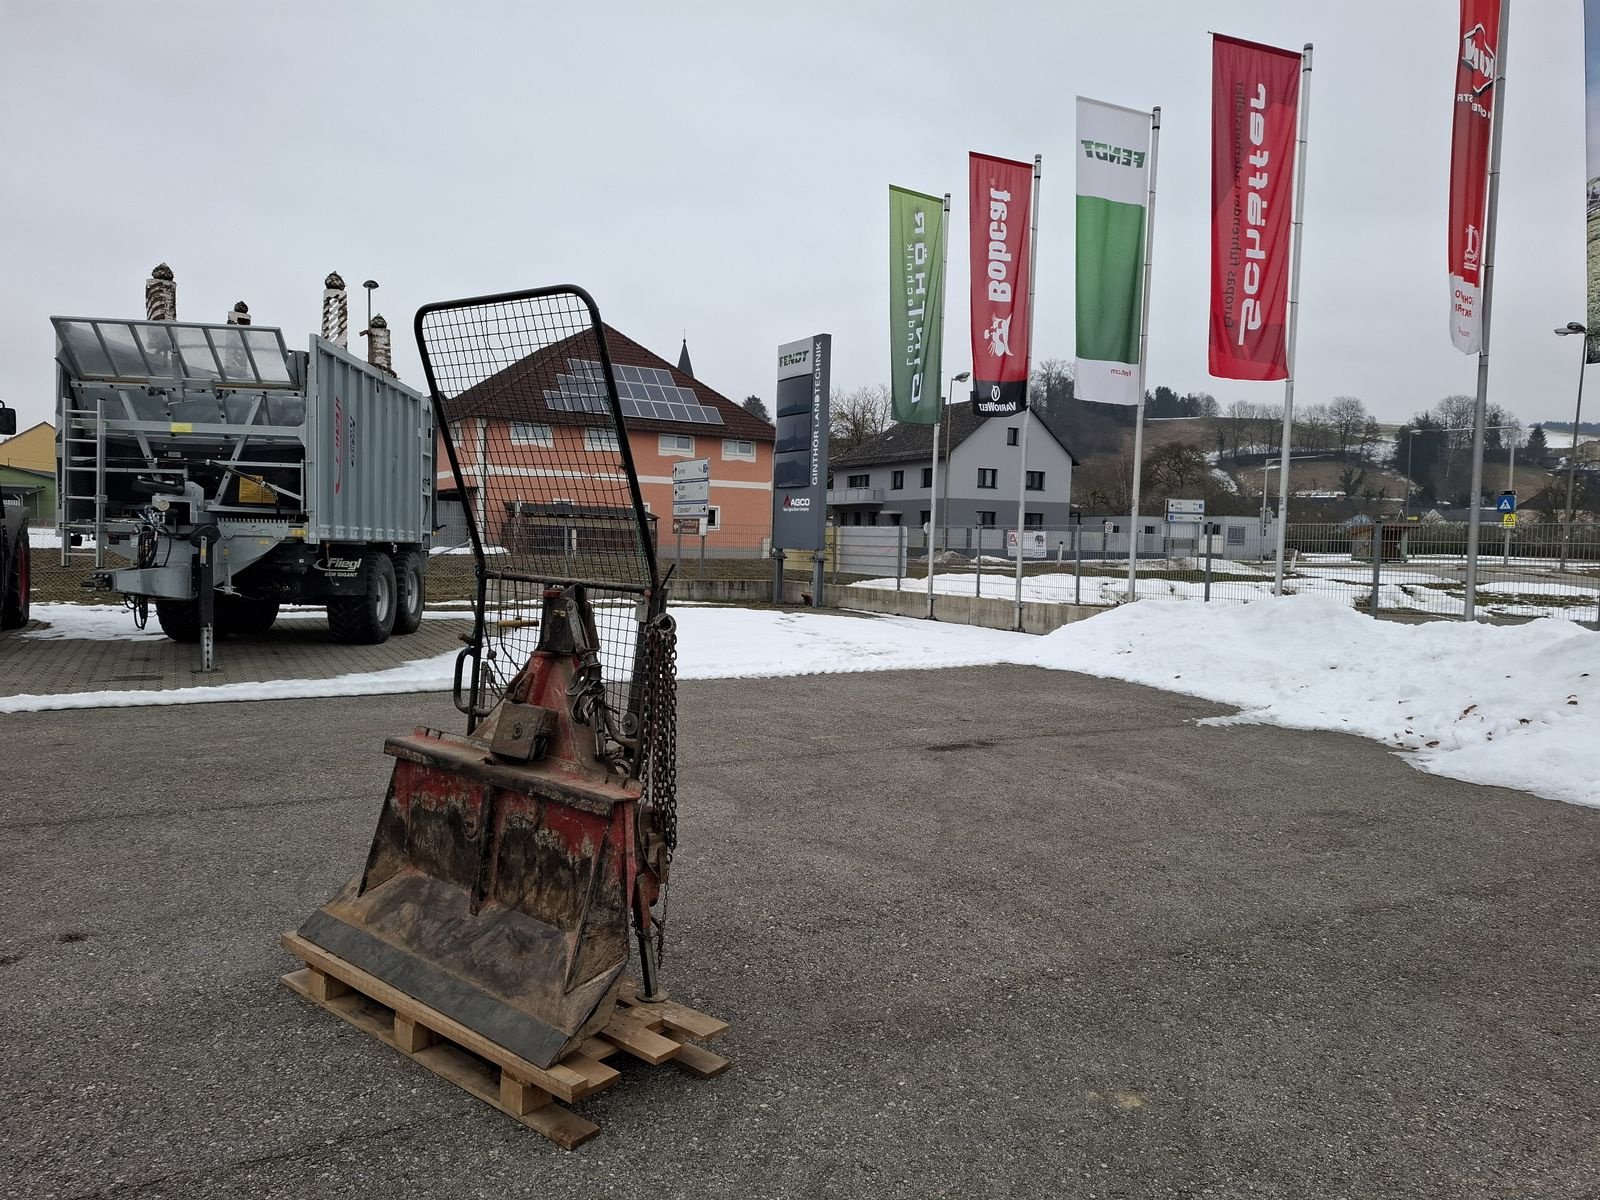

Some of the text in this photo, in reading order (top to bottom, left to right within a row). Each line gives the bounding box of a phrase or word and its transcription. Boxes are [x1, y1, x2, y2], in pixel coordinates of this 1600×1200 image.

[779, 350, 810, 368] FENDT
[814, 341, 822, 427] LANDTECHNIK
[790, 498, 811, 507] AGCO
[327, 557, 363, 570] Fliegl
